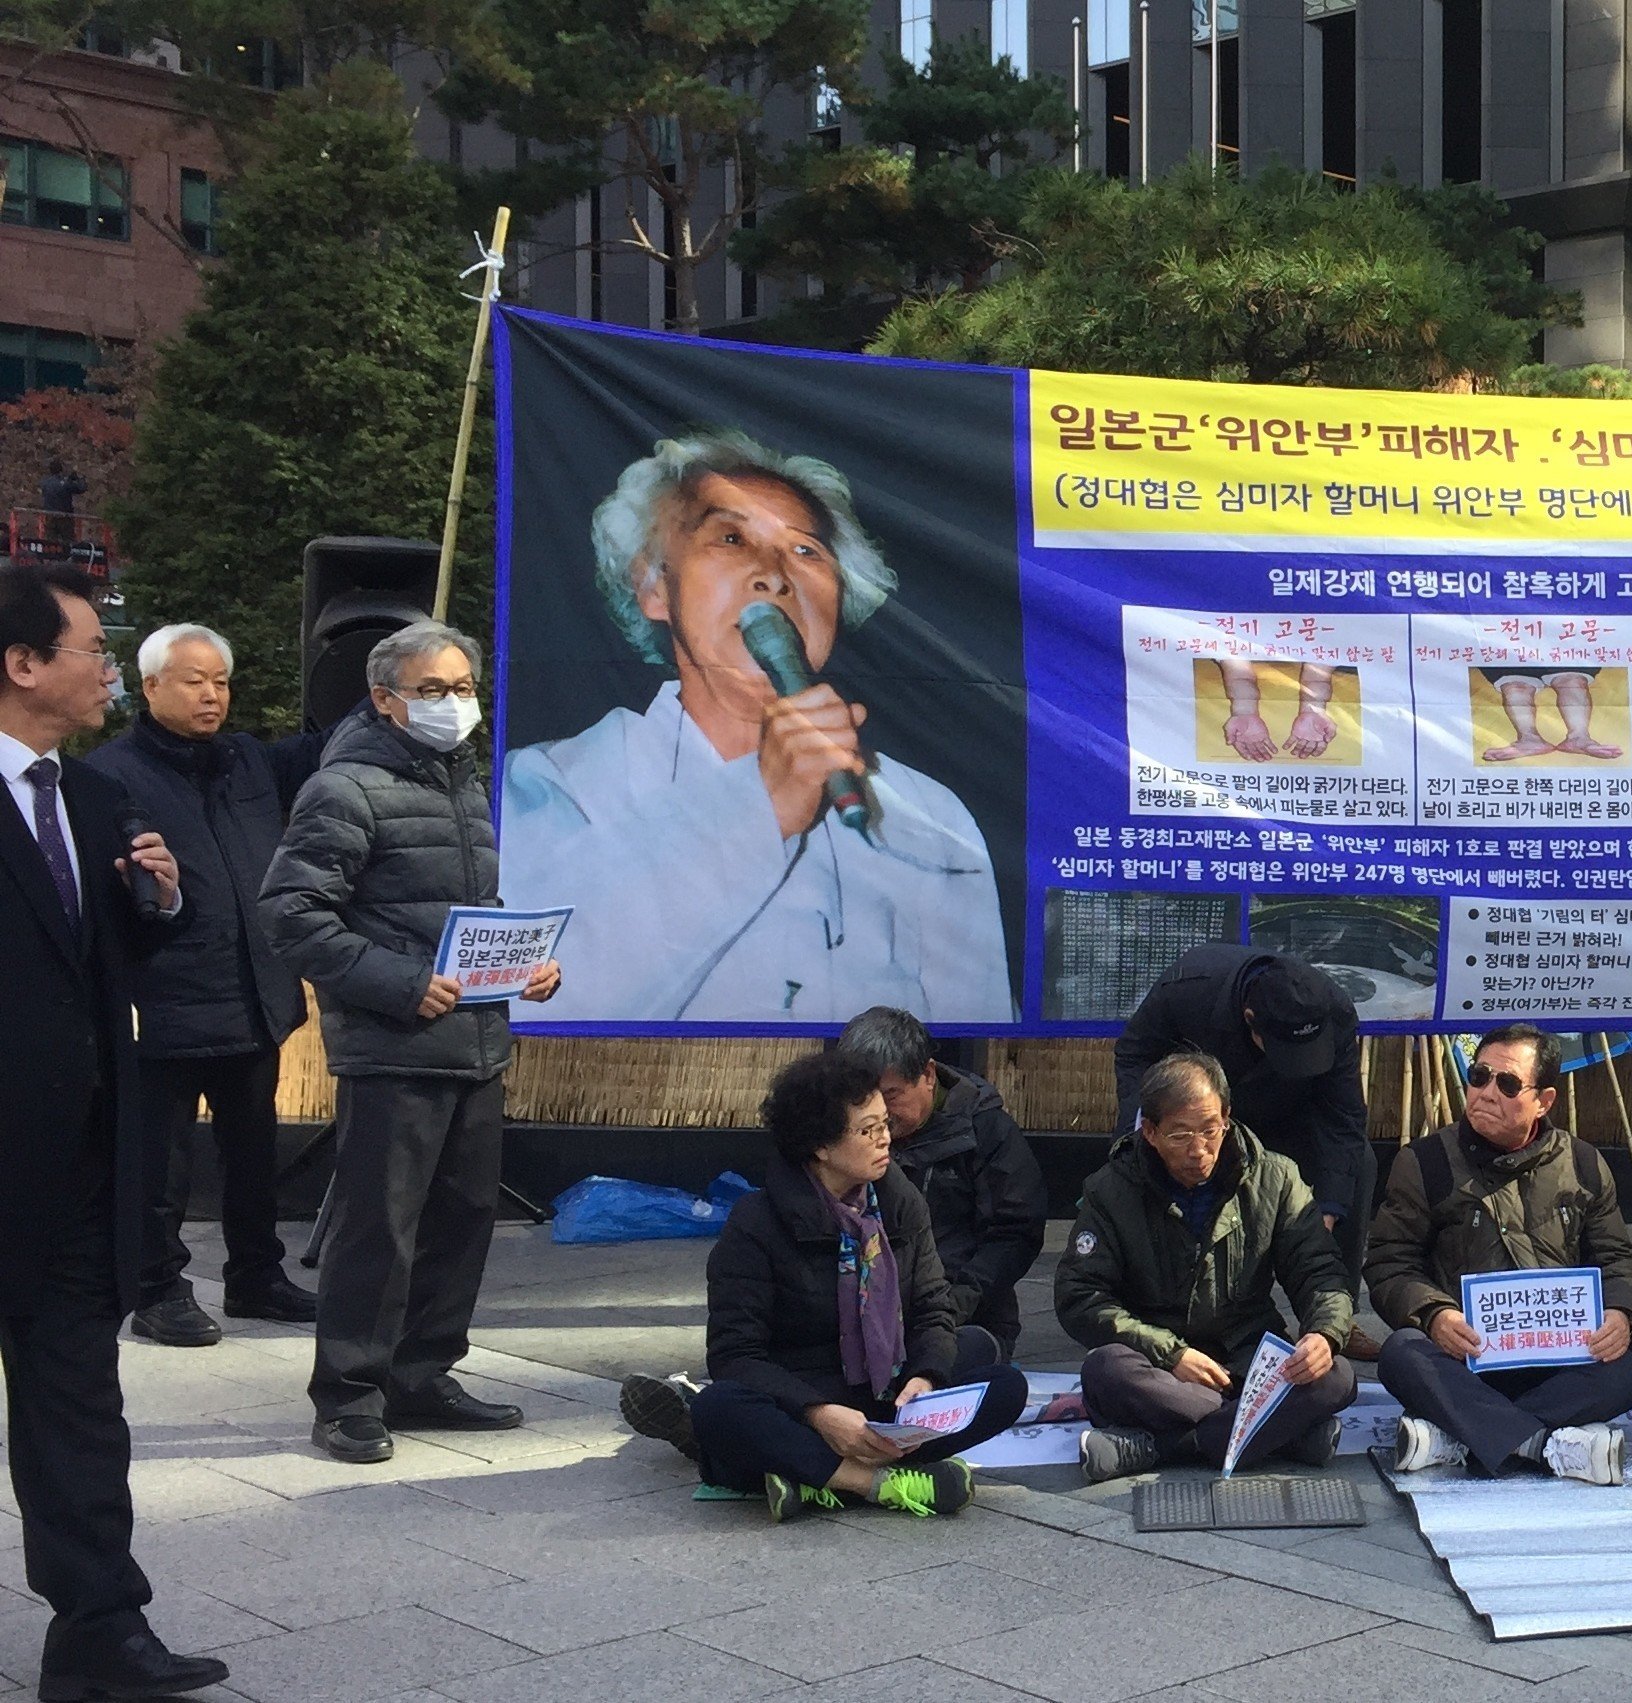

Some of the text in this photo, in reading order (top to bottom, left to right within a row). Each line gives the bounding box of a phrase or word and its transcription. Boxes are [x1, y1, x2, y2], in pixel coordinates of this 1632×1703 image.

[1049, 403, 1520, 463] 일본군‘위안부’피해자
[1053, 473, 1202, 512] (정대협은
[1216, 480, 1312, 514] 심미자
[1324, 482, 1419, 516] 할머니
[1433, 485, 1526, 518] 위안부
[1268, 568, 1376, 598] 일제강제
[1386, 569, 1492, 599] 연행되어
[1502, 570, 1607, 600] 참혹하게
[1137, 766, 1166, 784] 전기
[1172, 768, 1228, 786] 고문으로
[1232, 771, 1260, 788] 팔의
[1266, 773, 1309, 790] 길이와
[1362, 778, 1408, 795] 다르다.
[1427, 778, 1456, 796] 전기
[1461, 778, 1519, 796] 고문으로
[1525, 778, 1553, 796] 한쪽
[1559, 779, 1601, 796] 다리의
[1137, 789, 1197, 808] 한평생을
[1235, 794, 1277, 812] 속에서
[1281, 796, 1338, 814] 피눈물로
[1343, 799, 1372, 816] 살고
[1376, 801, 1408, 818] 있다.
[1423, 802, 1451, 818] 날이
[1457, 802, 1500, 818] 흐리고
[1507, 802, 1534, 818] 비가
[1540, 802, 1582, 818] 내리면
[1588, 802, 1602, 818] 온
[1074, 826, 1112, 848] 일본
[1119, 829, 1251, 851] 동경최고재판소
[1259, 832, 1314, 854] 일본군
[1322, 834, 1385, 856] ‘위안부’
[1394, 836, 1448, 858] 피해자
[1457, 838, 1501, 858] 1호로
[1507, 838, 1543, 860] 판결
[1549, 838, 1621, 860] 받았으며
[1051, 856, 1115, 879] ‘심미자
[1210, 858, 1286, 882] 정대협은
[1292, 861, 1348, 883] 위안부
[1355, 864, 1405, 885] 247명
[1411, 865, 1481, 888] 명단에서
[1488, 869, 1565, 889] 빼버렸다.
[1487, 908, 1531, 924] 정대협
[1485, 931, 1530, 946] 빼버린
[1536, 931, 1566, 947] 근거
[457, 944, 548, 968] 일본군위안부
[1484, 954, 1530, 969] 정대협
[1536, 954, 1581, 969] 심미자
[1587, 955, 1629, 969] 할머니
[1483, 977, 1594, 991] 맞는가? 아닌가?
[1481, 997, 1581, 1011] 정부(여가부)는
[1587, 996, 1616, 1010] 즉각
[1478, 1286, 1588, 1312] 심미자沈美子
[1481, 1308, 1588, 1333] 일본군위안부
